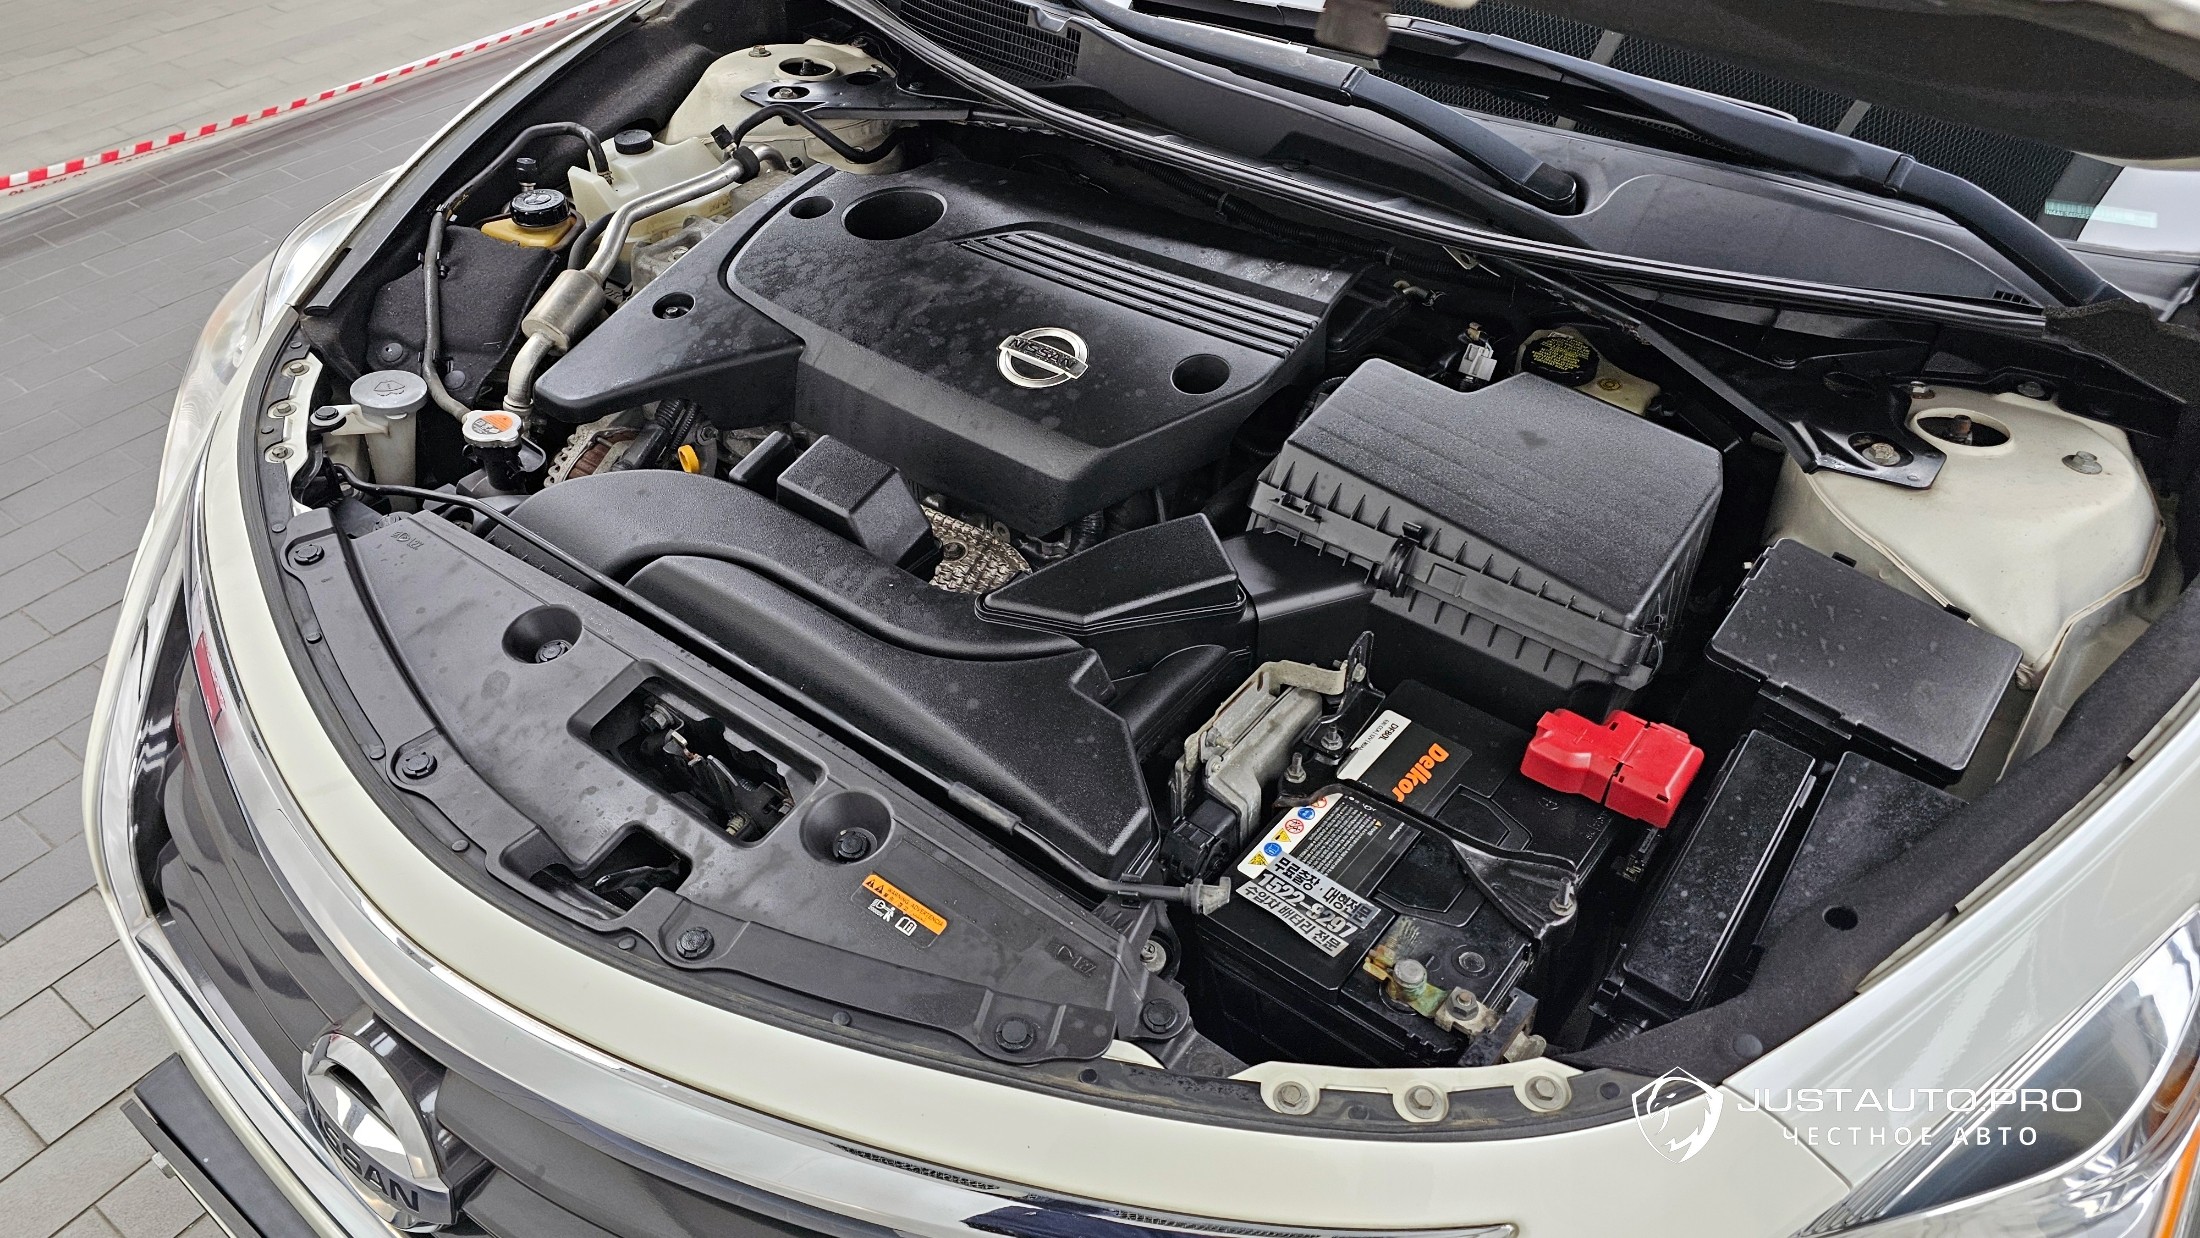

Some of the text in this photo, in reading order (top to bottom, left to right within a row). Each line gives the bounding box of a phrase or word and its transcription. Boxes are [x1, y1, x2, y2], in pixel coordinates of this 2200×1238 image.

[1009, 338, 1077, 370] NISSAN
[1392, 743, 1450, 802] Delkor
[887, 888, 910, 905] WARNING
[1257, 872, 1358, 938] 1522-8297
[1275, 857, 1373, 923] 무료출장 대형전문
[1278, 906, 1314, 934] 배터리
[1314, 930, 1341, 951] 전문
